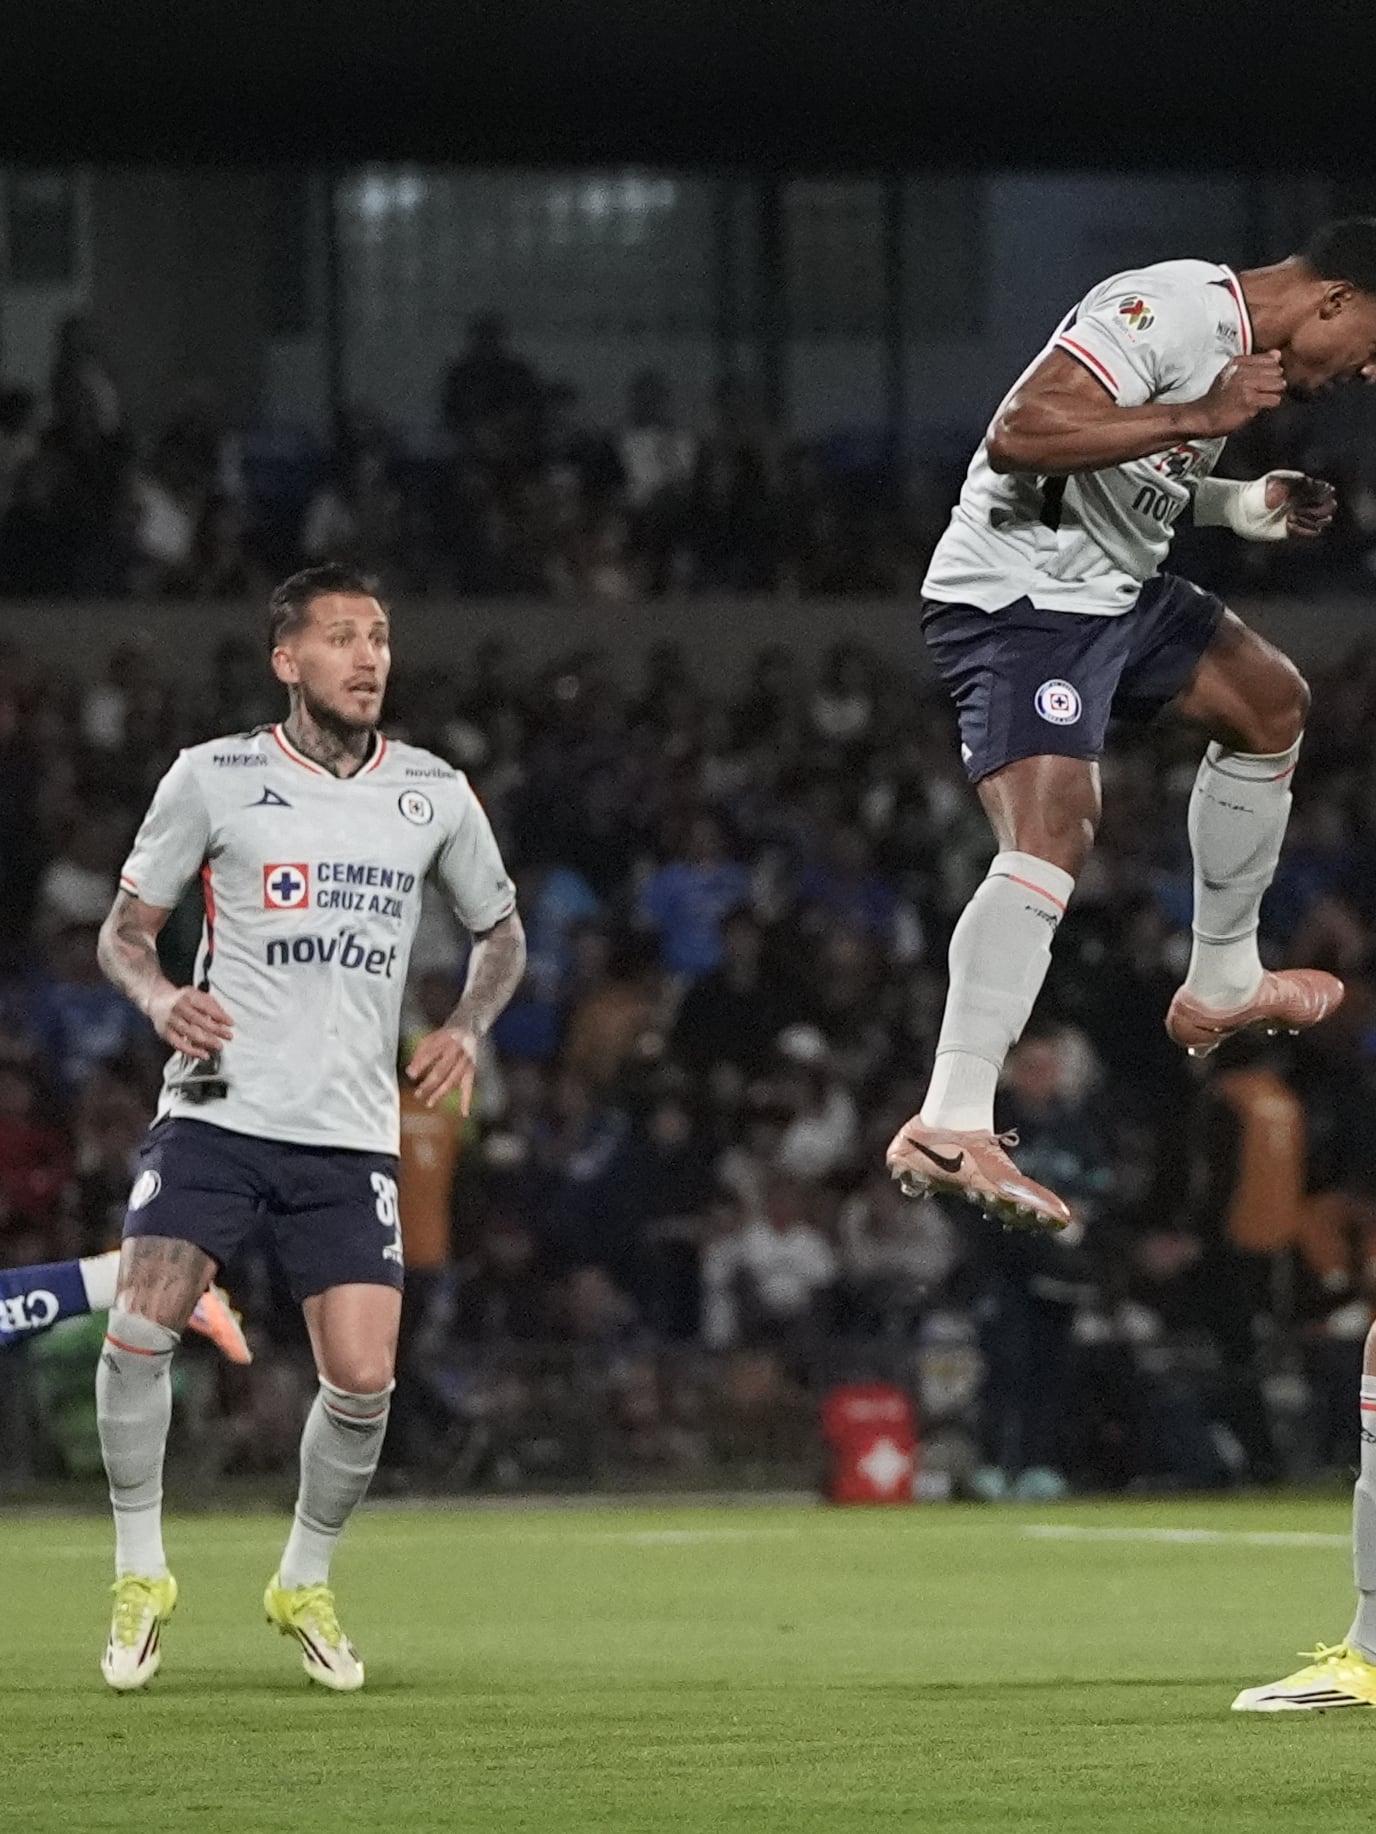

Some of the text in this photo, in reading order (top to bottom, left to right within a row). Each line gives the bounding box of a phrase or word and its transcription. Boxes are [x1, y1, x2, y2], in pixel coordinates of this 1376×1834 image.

[317, 862, 415, 893] CEMENTO
[316, 890, 403, 919] CRUZ AZUL
[266, 929, 397, 979] novibet
